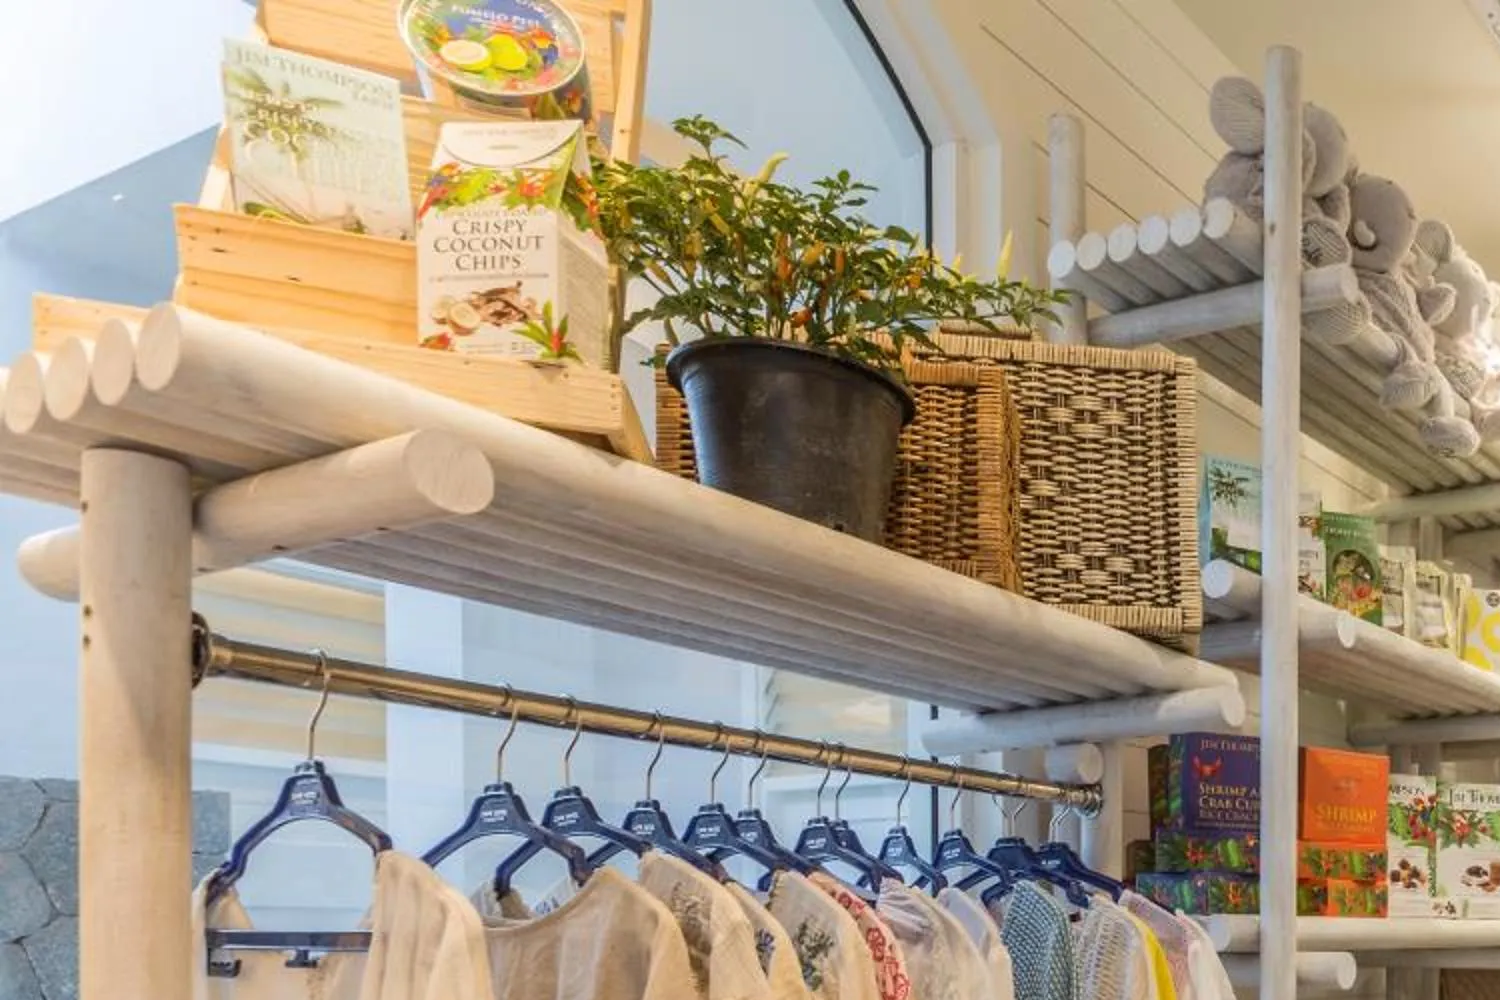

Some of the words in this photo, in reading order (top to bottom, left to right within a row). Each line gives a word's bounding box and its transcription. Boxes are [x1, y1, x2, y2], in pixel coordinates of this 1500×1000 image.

[452, 219, 527, 235] CRISPY
[433, 235, 544, 253] COCONUT
[455, 254, 521, 271] CHIPS
[1315, 803, 1378, 824] SHRIMP
